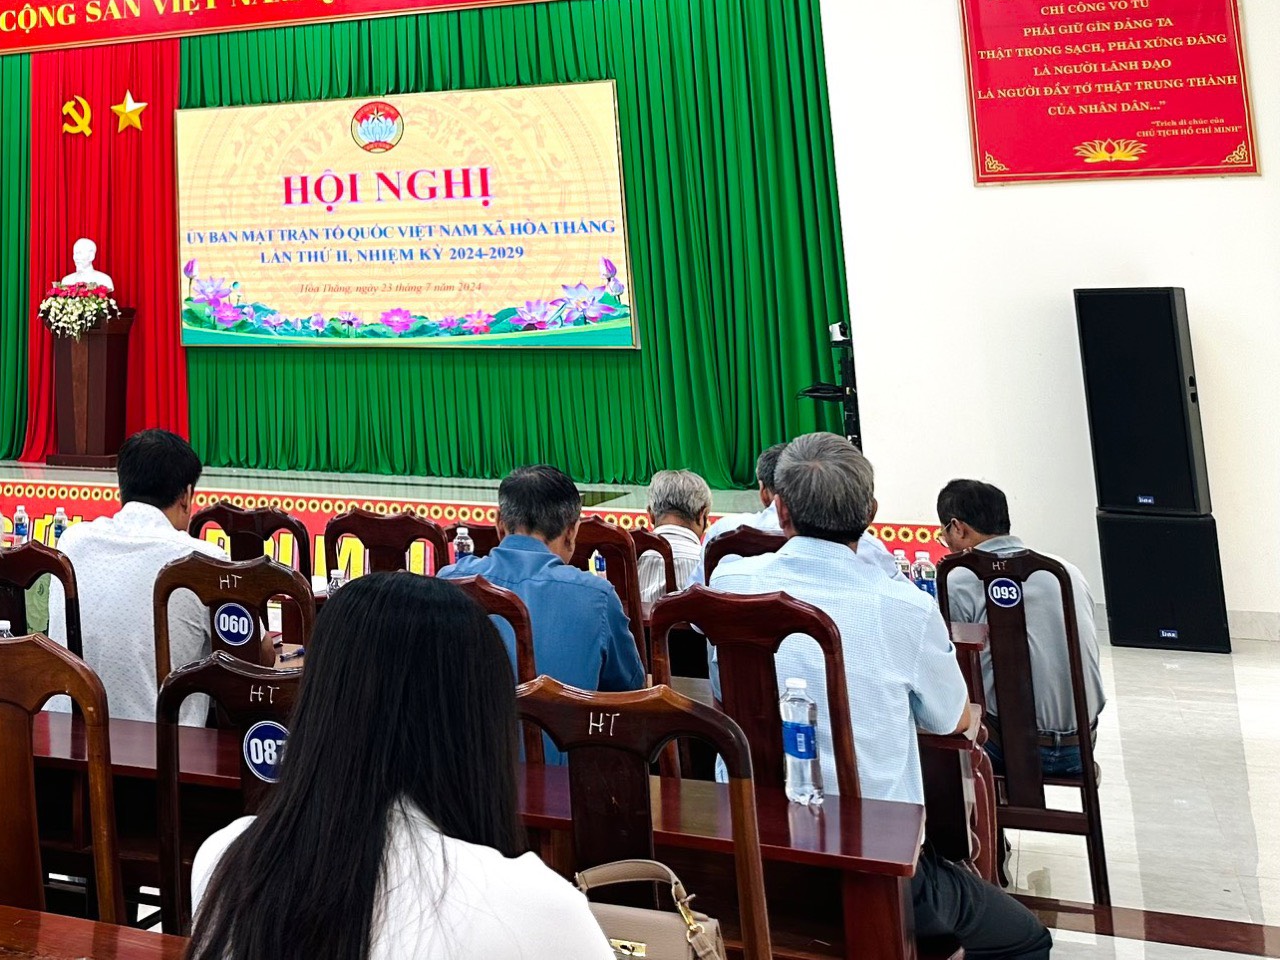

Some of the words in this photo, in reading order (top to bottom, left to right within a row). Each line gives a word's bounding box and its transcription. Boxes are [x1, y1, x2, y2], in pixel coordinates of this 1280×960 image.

[0, 0, 77, 30] CỘNG
[283, 168, 360, 212] HỘI
[375, 167, 493, 206] NGHỊ
[209, 231, 239, 243] BAN
[397, 225, 437, 240] VIỆT
[439, 224, 478, 236] NAM
[482, 220, 507, 235] XÃ
[510, 218, 549, 234] HÒA
[297, 246, 332, 262] THỨ
[337, 250, 352, 262] II,
[357, 248, 413, 263] NHIỆM
[420, 244, 443, 262] KỲ
[450, 246, 524, 259] 2024-2029
[219, 574, 242, 589] HT
[992, 586, 1017, 599] 093
[220, 613, 249, 635] 060
[250, 684, 280, 704] HT
[589, 711, 620, 737] HT
